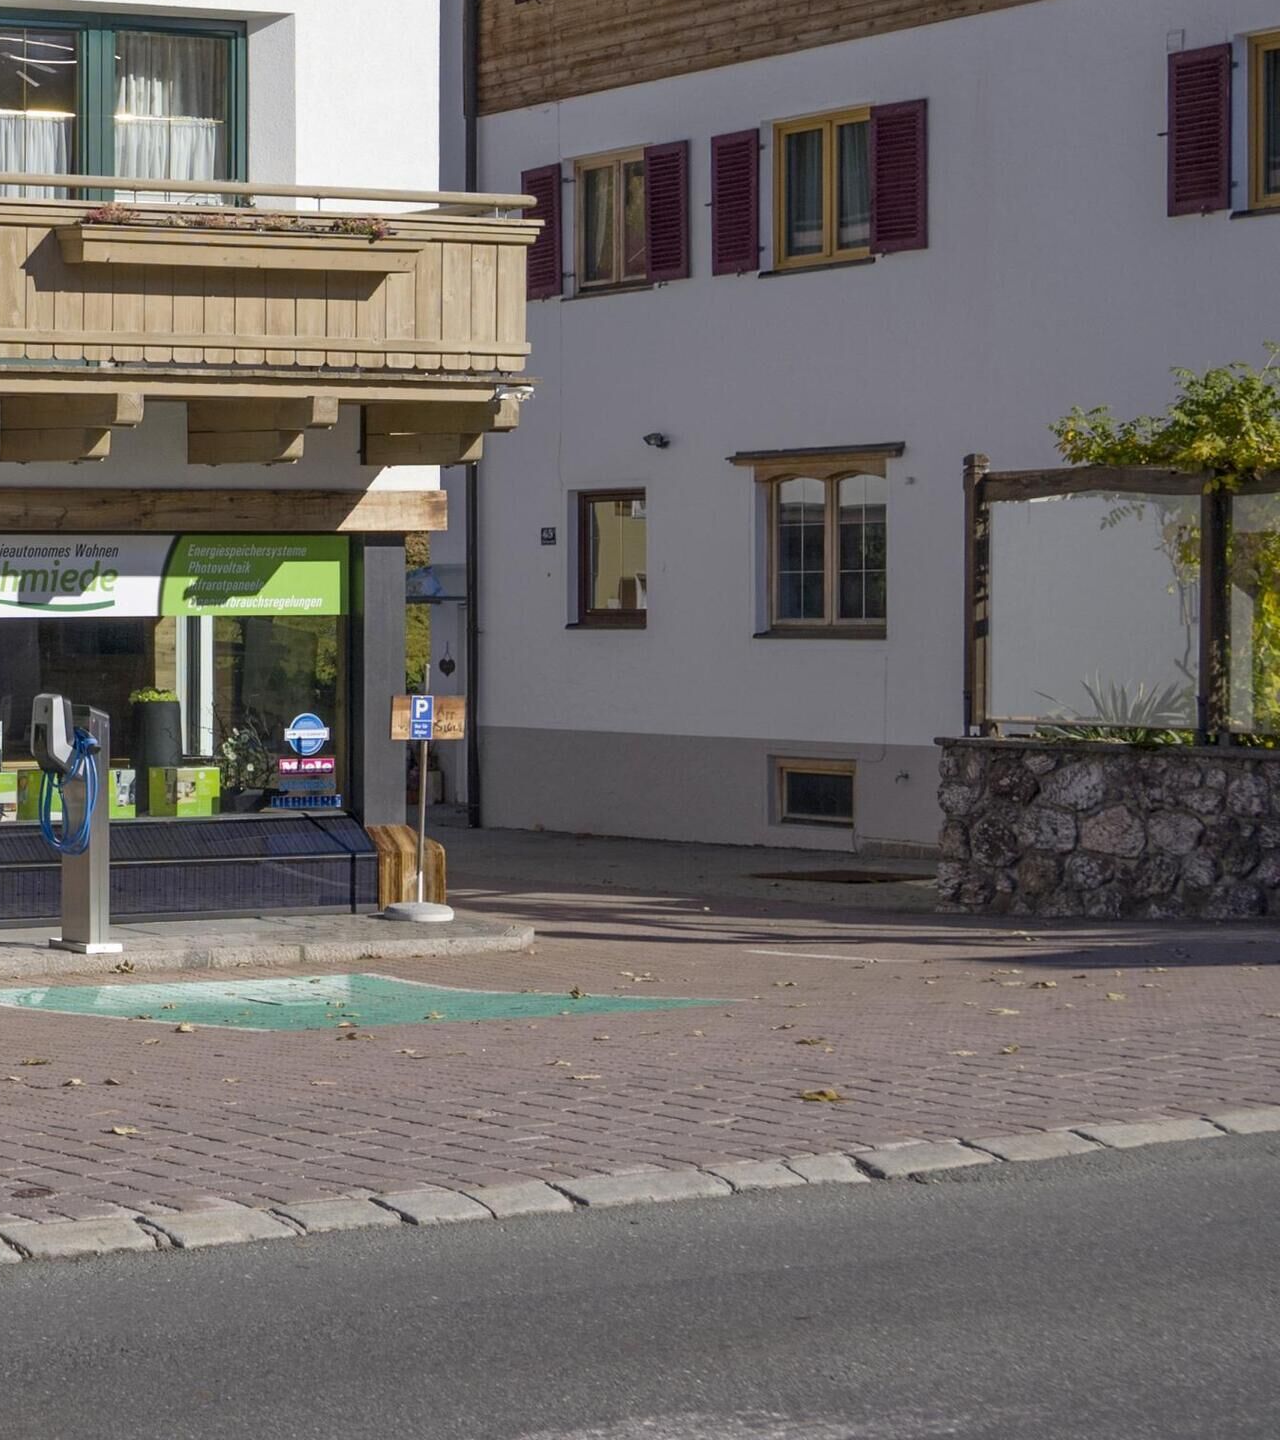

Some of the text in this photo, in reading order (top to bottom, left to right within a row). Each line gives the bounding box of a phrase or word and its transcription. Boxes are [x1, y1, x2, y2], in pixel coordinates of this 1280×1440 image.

[75, 544, 119, 558] Wohnen
[187, 544, 308, 559] Energiespeichersysteme
[187, 561, 251, 574] Photovoltaik
[187, 596, 323, 611] Eigenverbrauchsregelungen
[415, 699, 429, 719] P
[282, 761, 333, 773] Miele
